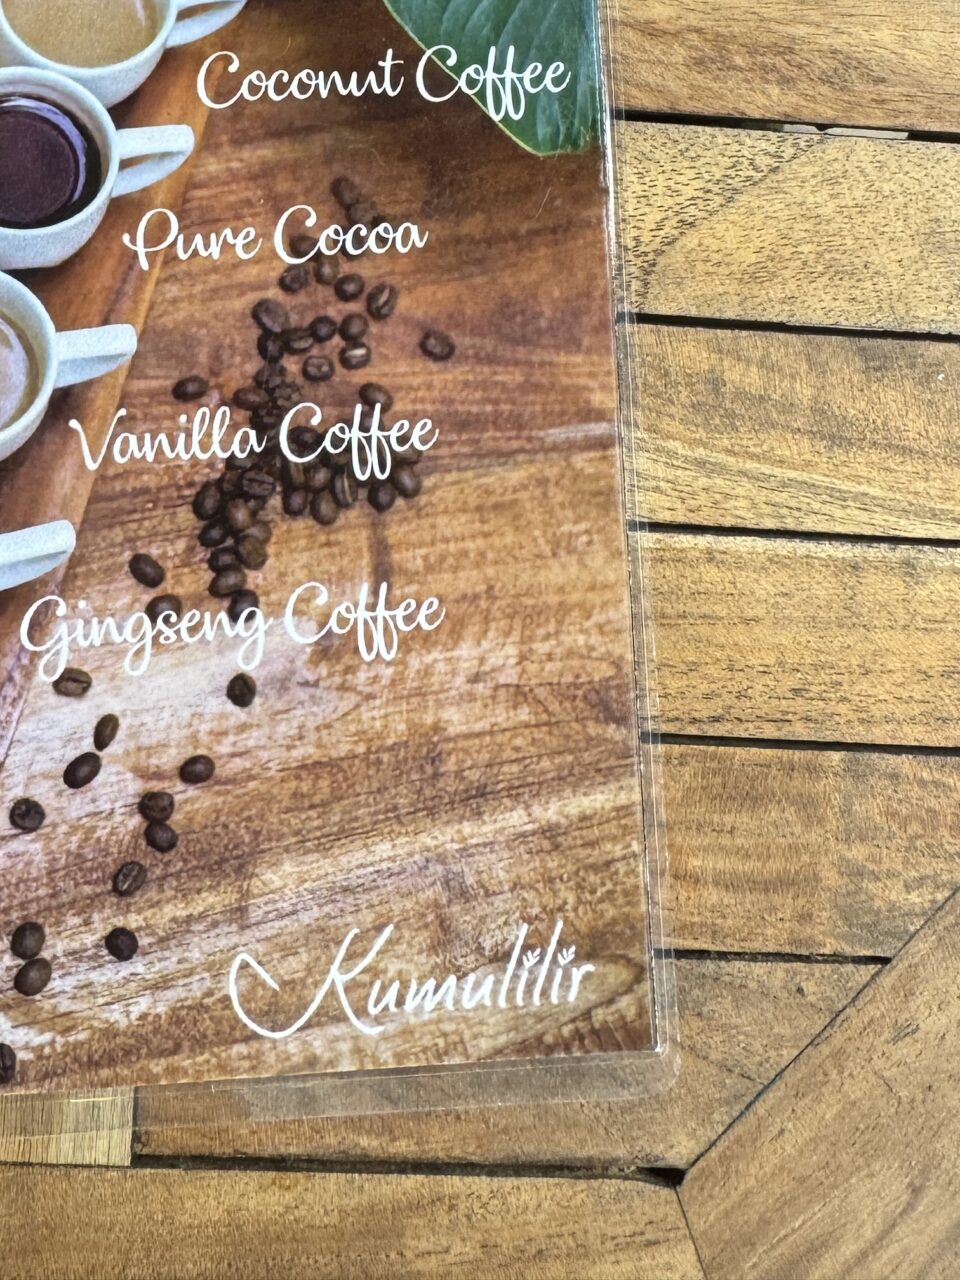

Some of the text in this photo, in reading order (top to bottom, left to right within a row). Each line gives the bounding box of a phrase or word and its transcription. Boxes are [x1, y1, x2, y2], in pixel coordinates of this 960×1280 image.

[196, 44, 571, 121] Coconut Coffee
[122, 204, 429, 271] Pure Cocoa
[68, 402, 440, 481] Vanilla Coffee
[19, 581, 446, 682] Gingseng Coffee
[228, 919, 596, 1040] Kumulilir
